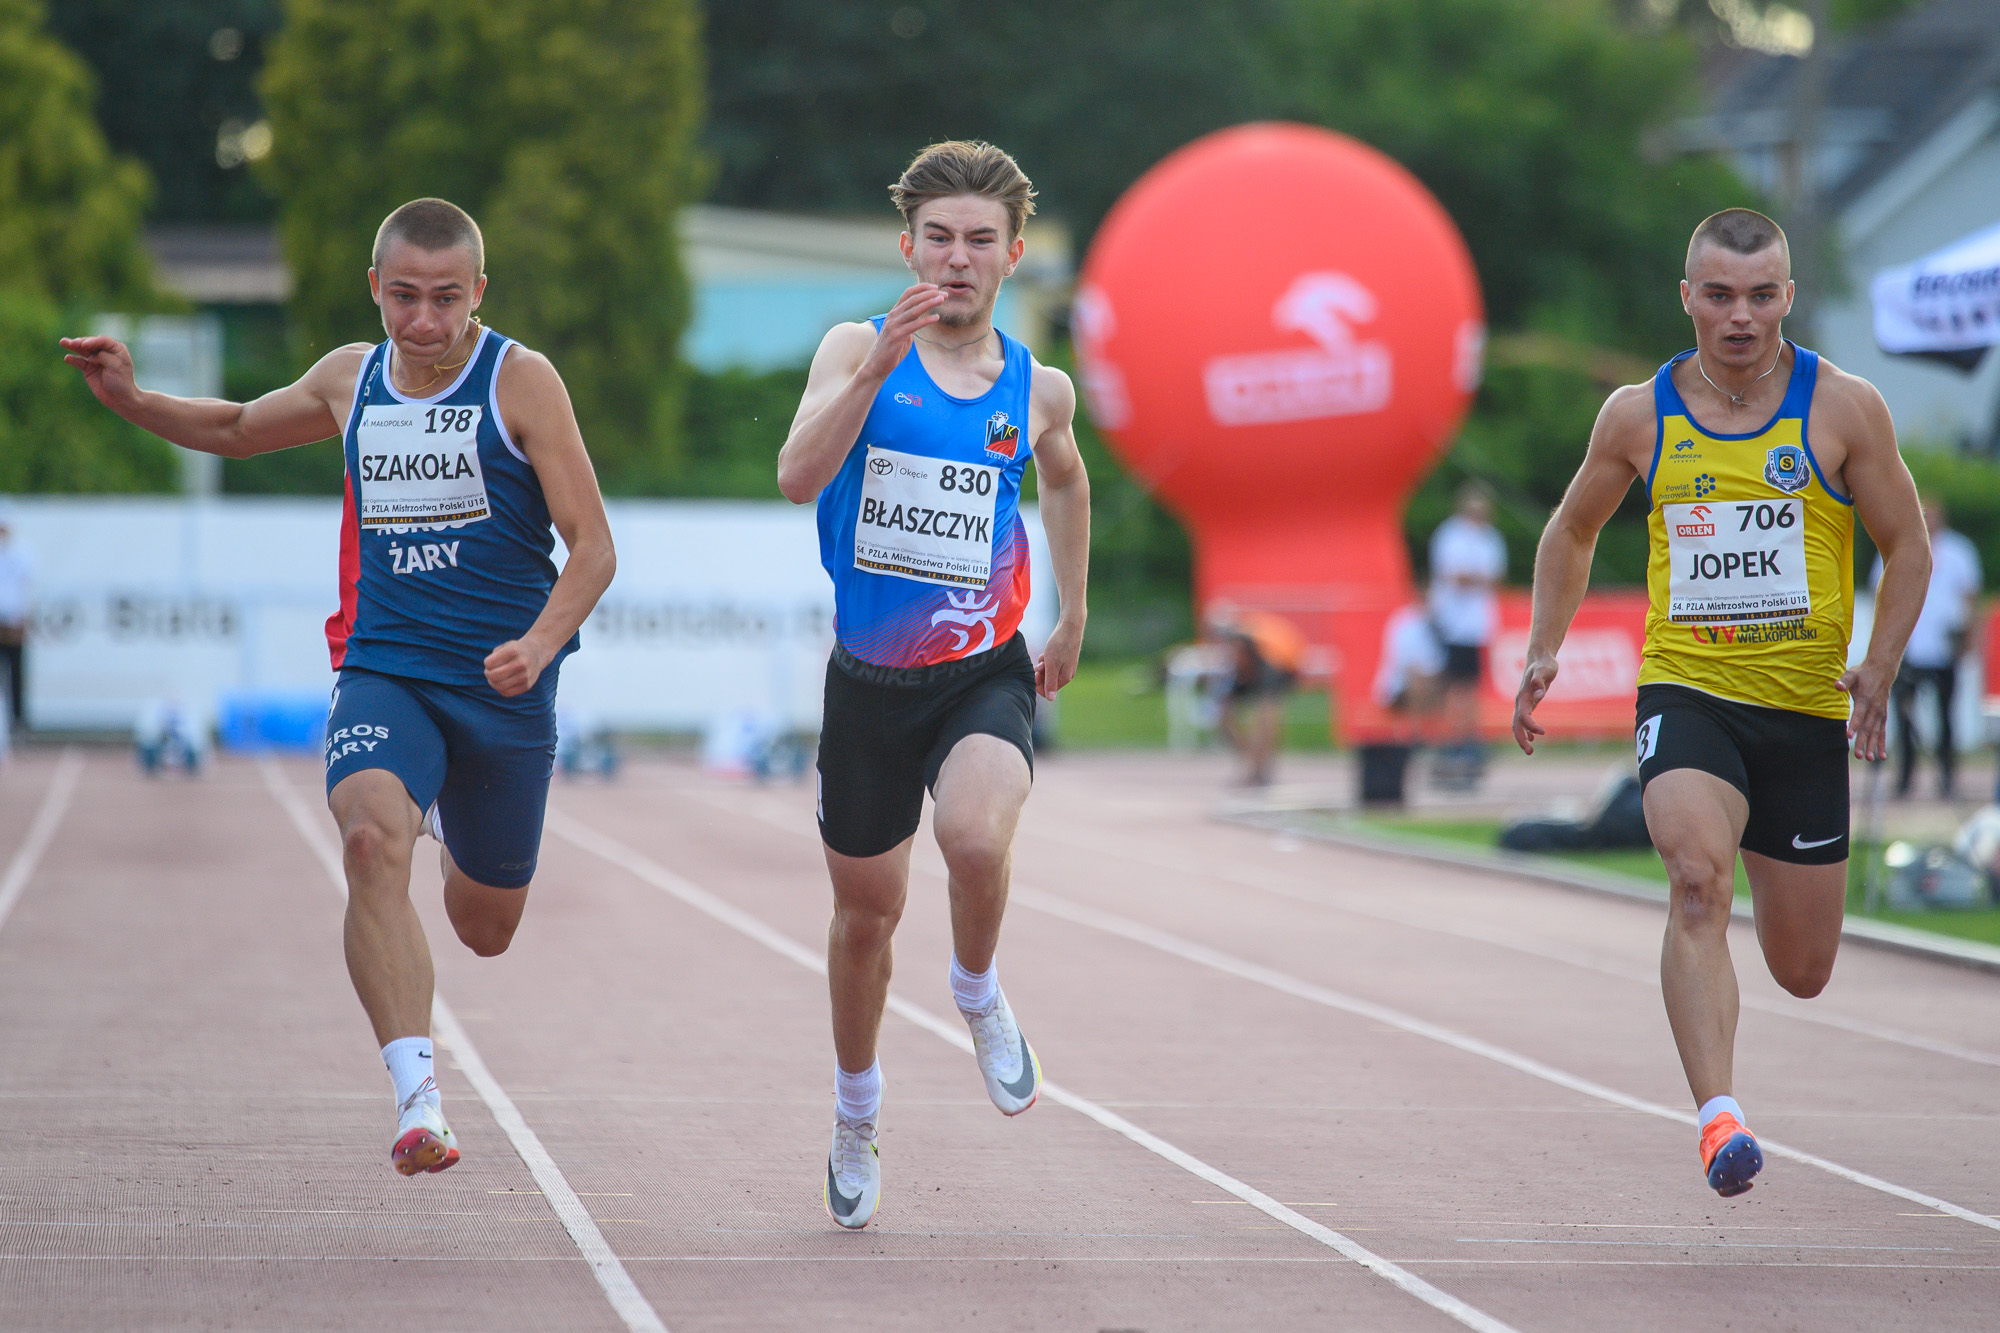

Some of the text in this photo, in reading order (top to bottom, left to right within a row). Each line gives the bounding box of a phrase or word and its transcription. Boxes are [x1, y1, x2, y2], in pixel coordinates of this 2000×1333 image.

[371, 420, 413, 428] MAŁOPOLSKA
[424, 408, 473, 434] 198
[362, 452, 475, 482] SZAKOŁA
[899, 466, 928, 480] Okęcie
[939, 465, 992, 496] 830
[1658, 490, 1691, 501] Ostrowski
[1665, 483, 1689, 492] Powiat
[372, 504, 389, 513] PZLA
[392, 503, 437, 513] Mistrzostwa
[440, 501, 465, 511] Polski
[468, 497, 485, 507] U18
[1736, 503, 1795, 532] 706
[862, 497, 989, 543] BŁASZCZYK
[1678, 525, 1713, 536] ORLEN
[388, 540, 460, 575] ŻARY
[857, 545, 988, 575] 54. PZLA Mistrzostwa Polski U18
[1689, 549, 1781, 581] JOPEK
[858, 558, 985, 585] BIELSKO-BIAŁA 15-17.07.2022
[1672, 595, 1807, 611] 54. PZLA Mistrzostwa Polski U18
[1736, 628, 1817, 644] WIELKOPOLSKI
[325, 740, 378, 774] ARY
[1638, 723, 1650, 764] 3
